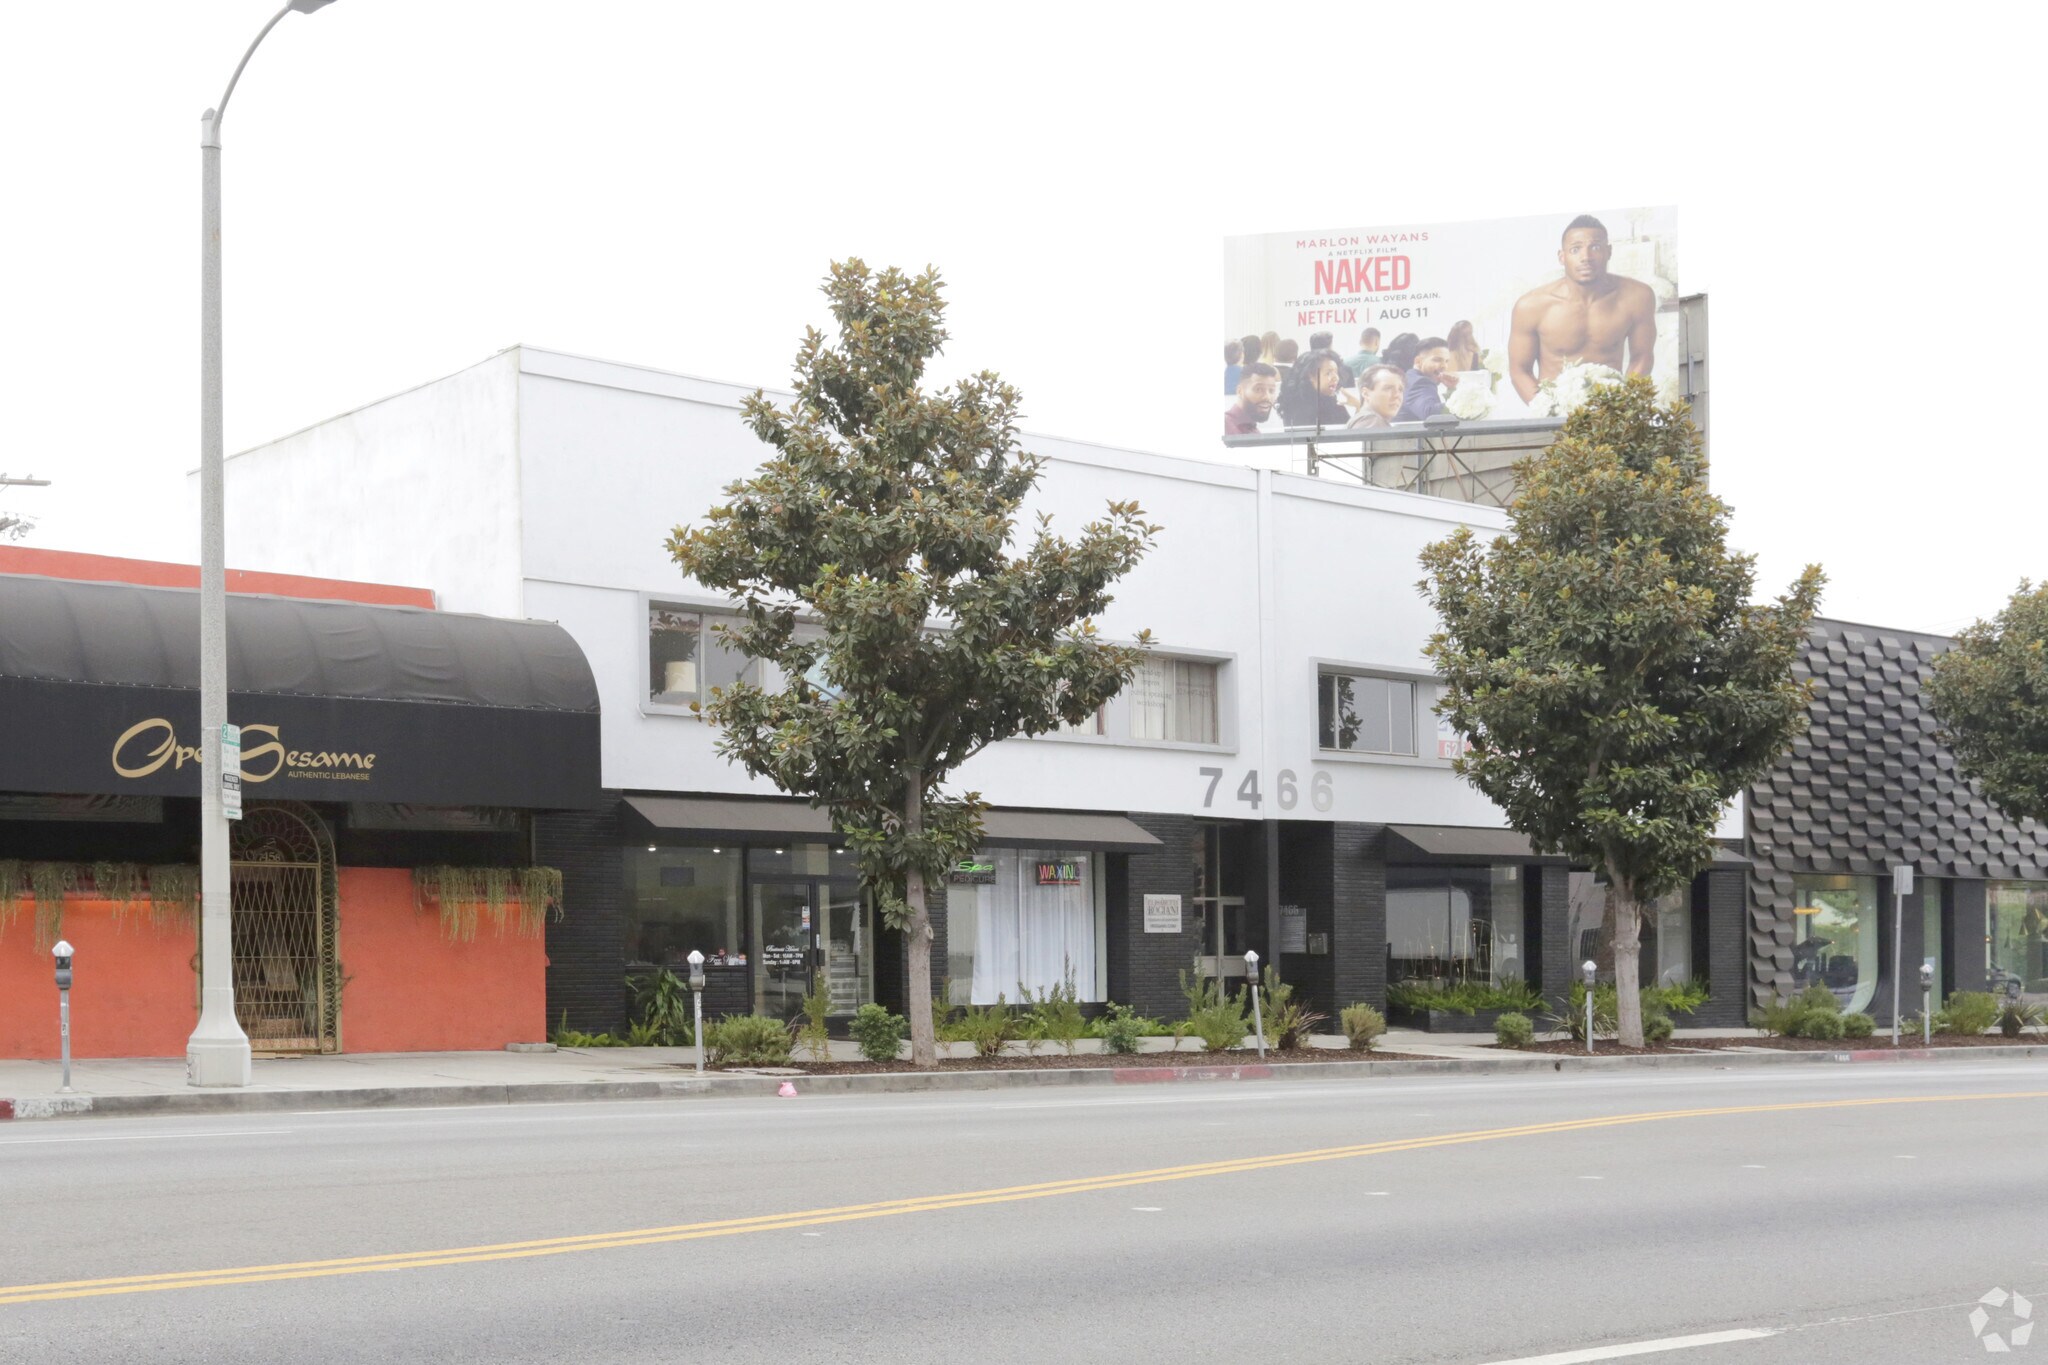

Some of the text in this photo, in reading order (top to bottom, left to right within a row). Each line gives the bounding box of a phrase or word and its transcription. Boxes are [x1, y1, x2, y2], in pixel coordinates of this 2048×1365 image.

[1296, 232, 1429, 249] MARLON WAYANS
[1336, 248, 1373, 256] NETFLIX
[1314, 255, 1411, 295] NAKED
[1383, 294, 1407, 302] OVER
[1410, 292, 1441, 300] AGAIN.
[1298, 307, 1428, 326] NETFLIX AUG 11
[112, 718, 376, 783] Ope Sesame
[288, 771, 331, 779] AUTHENTIC
[1199, 766, 1334, 813] 7466
[958, 861, 993, 873] Spa
[1039, 864, 1080, 879] WAXING
[953, 874, 996, 884] PEDICURE
